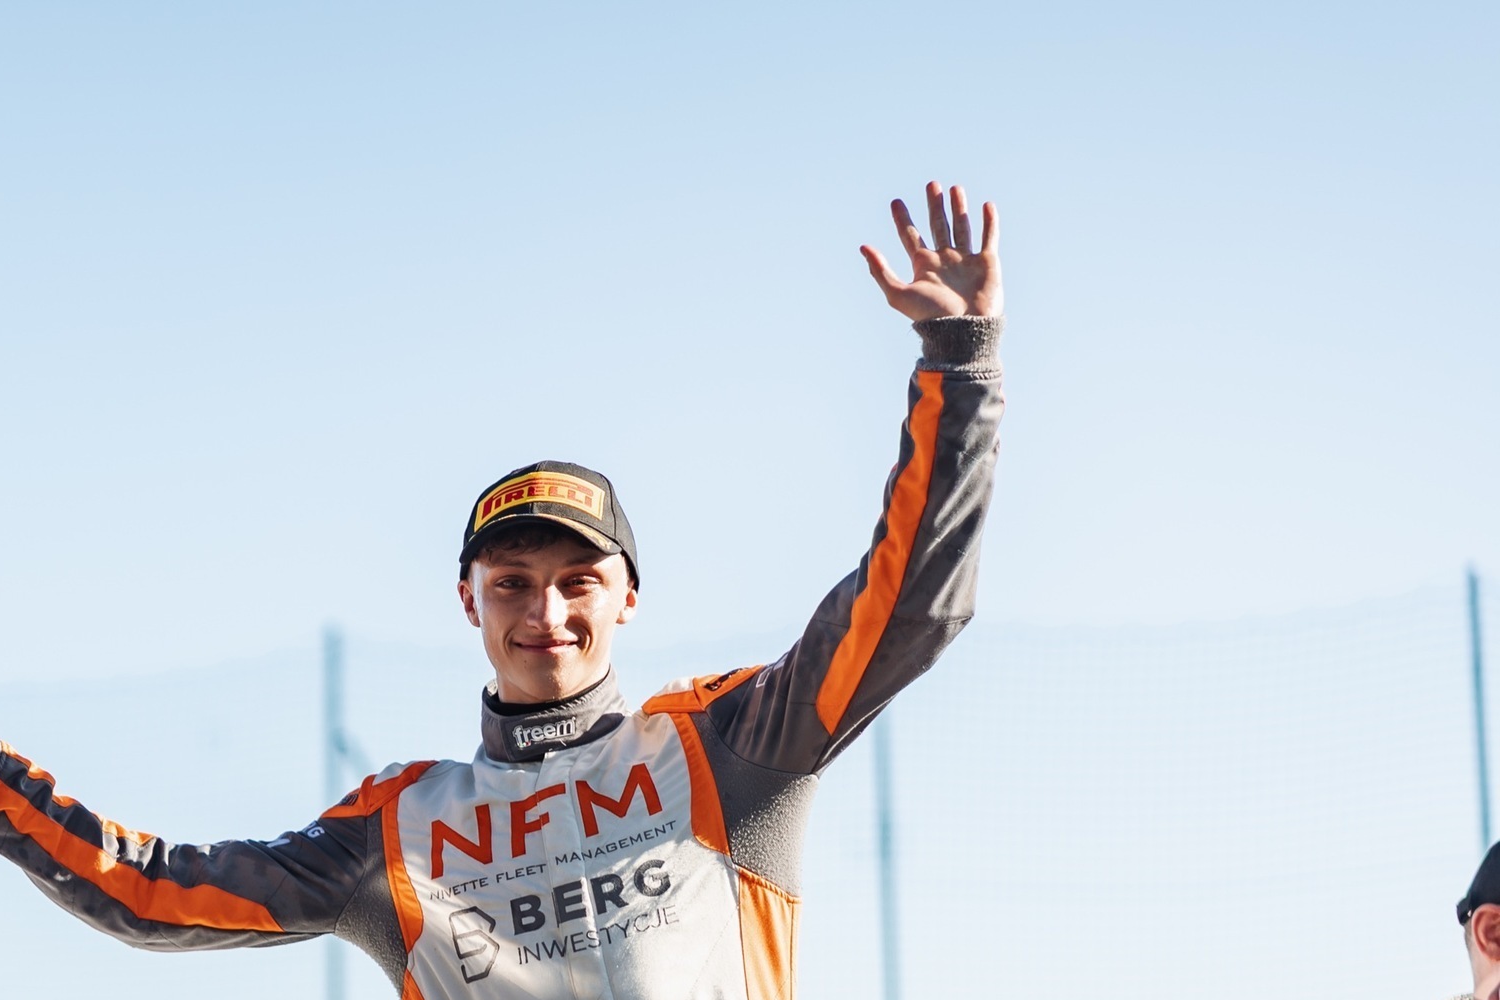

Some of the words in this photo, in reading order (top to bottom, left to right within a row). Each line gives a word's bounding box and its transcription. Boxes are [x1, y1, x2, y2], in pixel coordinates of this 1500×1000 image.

[481, 473, 595, 519] PIRELLI
[511, 715, 577, 749] freem
[430, 762, 664, 881] NFM
[429, 875, 490, 902] NIVETTE
[495, 862, 548, 887] FLEET
[554, 819, 678, 868] MANAGEMENT
[510, 858, 672, 937] BERG
[516, 905, 681, 966] INWESTYCJE
